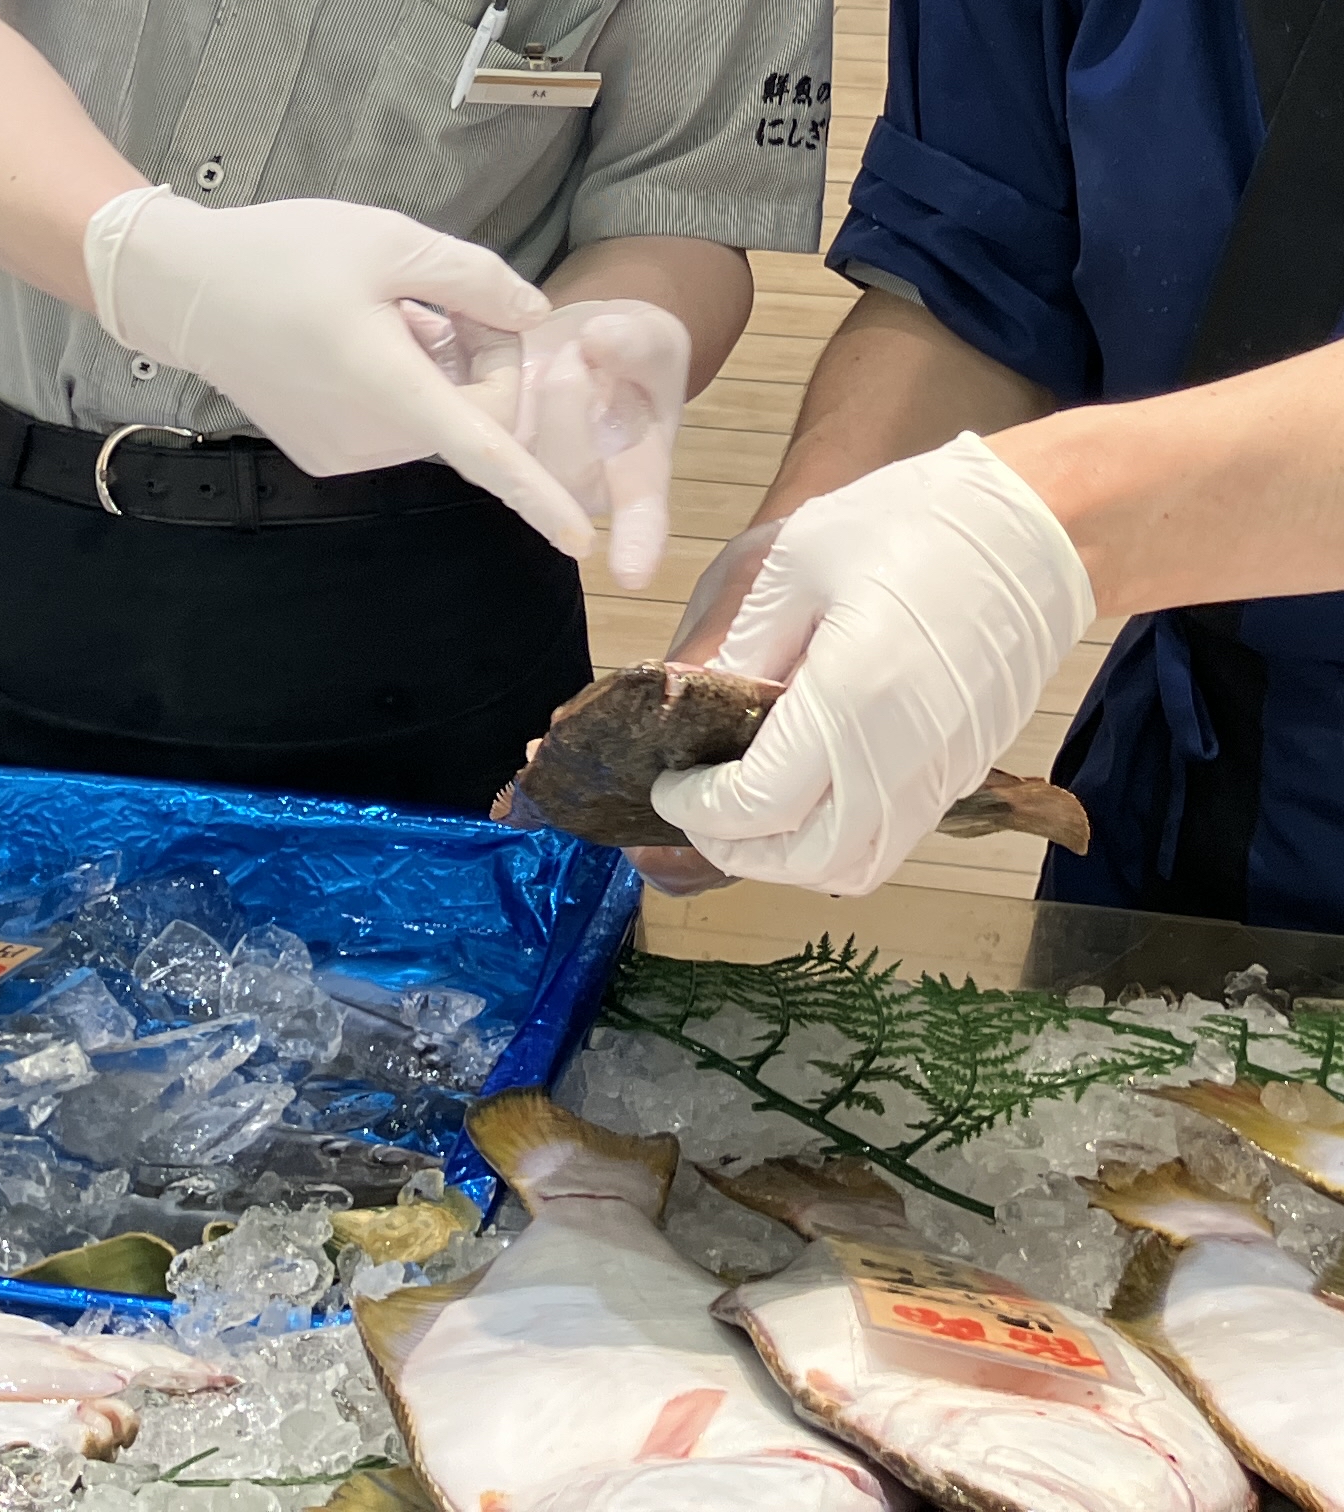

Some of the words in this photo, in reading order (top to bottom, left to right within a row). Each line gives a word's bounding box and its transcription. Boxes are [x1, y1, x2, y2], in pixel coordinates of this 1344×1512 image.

[763, 72, 831, 107] 鮮魚の
[755, 118, 829, 149] にしざ
